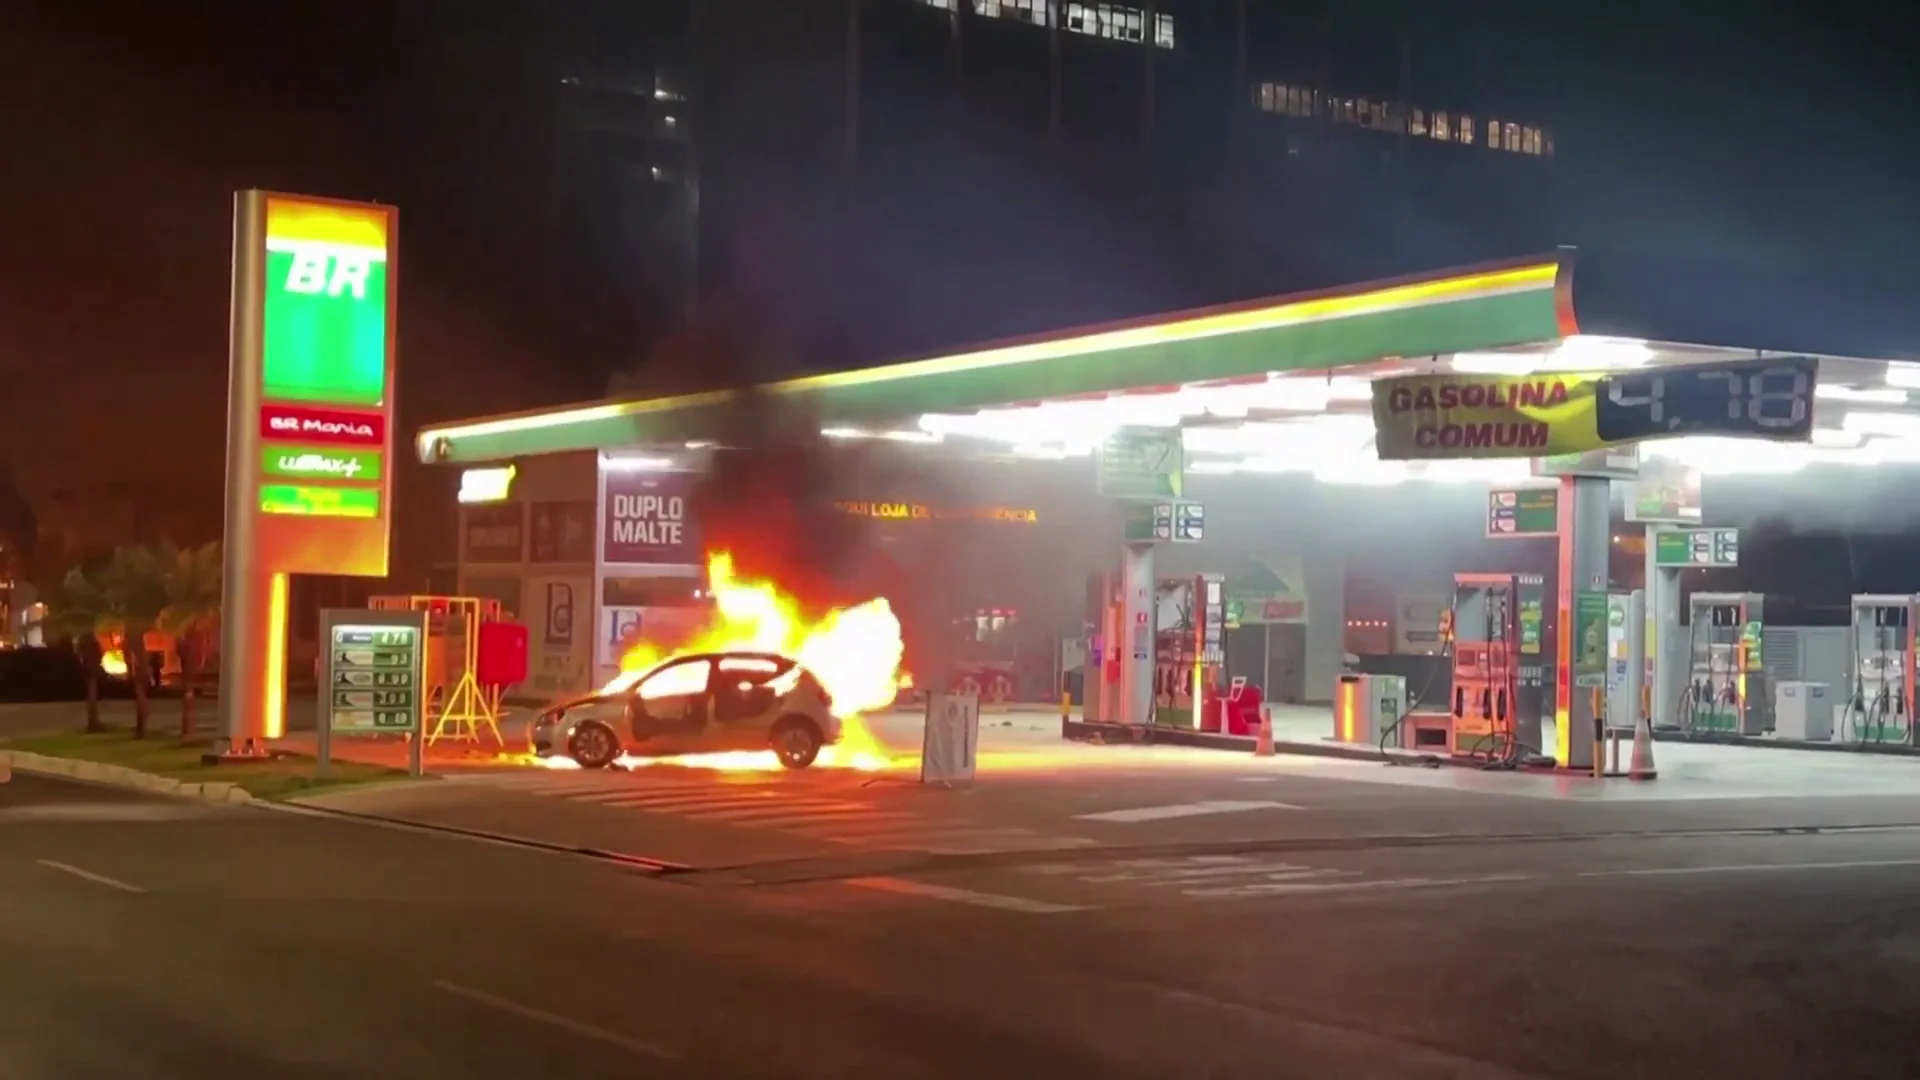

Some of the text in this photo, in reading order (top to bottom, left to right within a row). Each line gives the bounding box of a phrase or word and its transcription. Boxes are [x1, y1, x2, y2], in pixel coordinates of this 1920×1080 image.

[284, 248, 369, 300] BR
[1389, 380, 1569, 414] GASOLINA
[270, 416, 374, 436] BR Mania
[1415, 423, 1549, 449] COMUM
[614, 495, 682, 520] DUPLO
[871, 503, 909, 518] LOJA
[613, 521, 682, 544] MALTE
